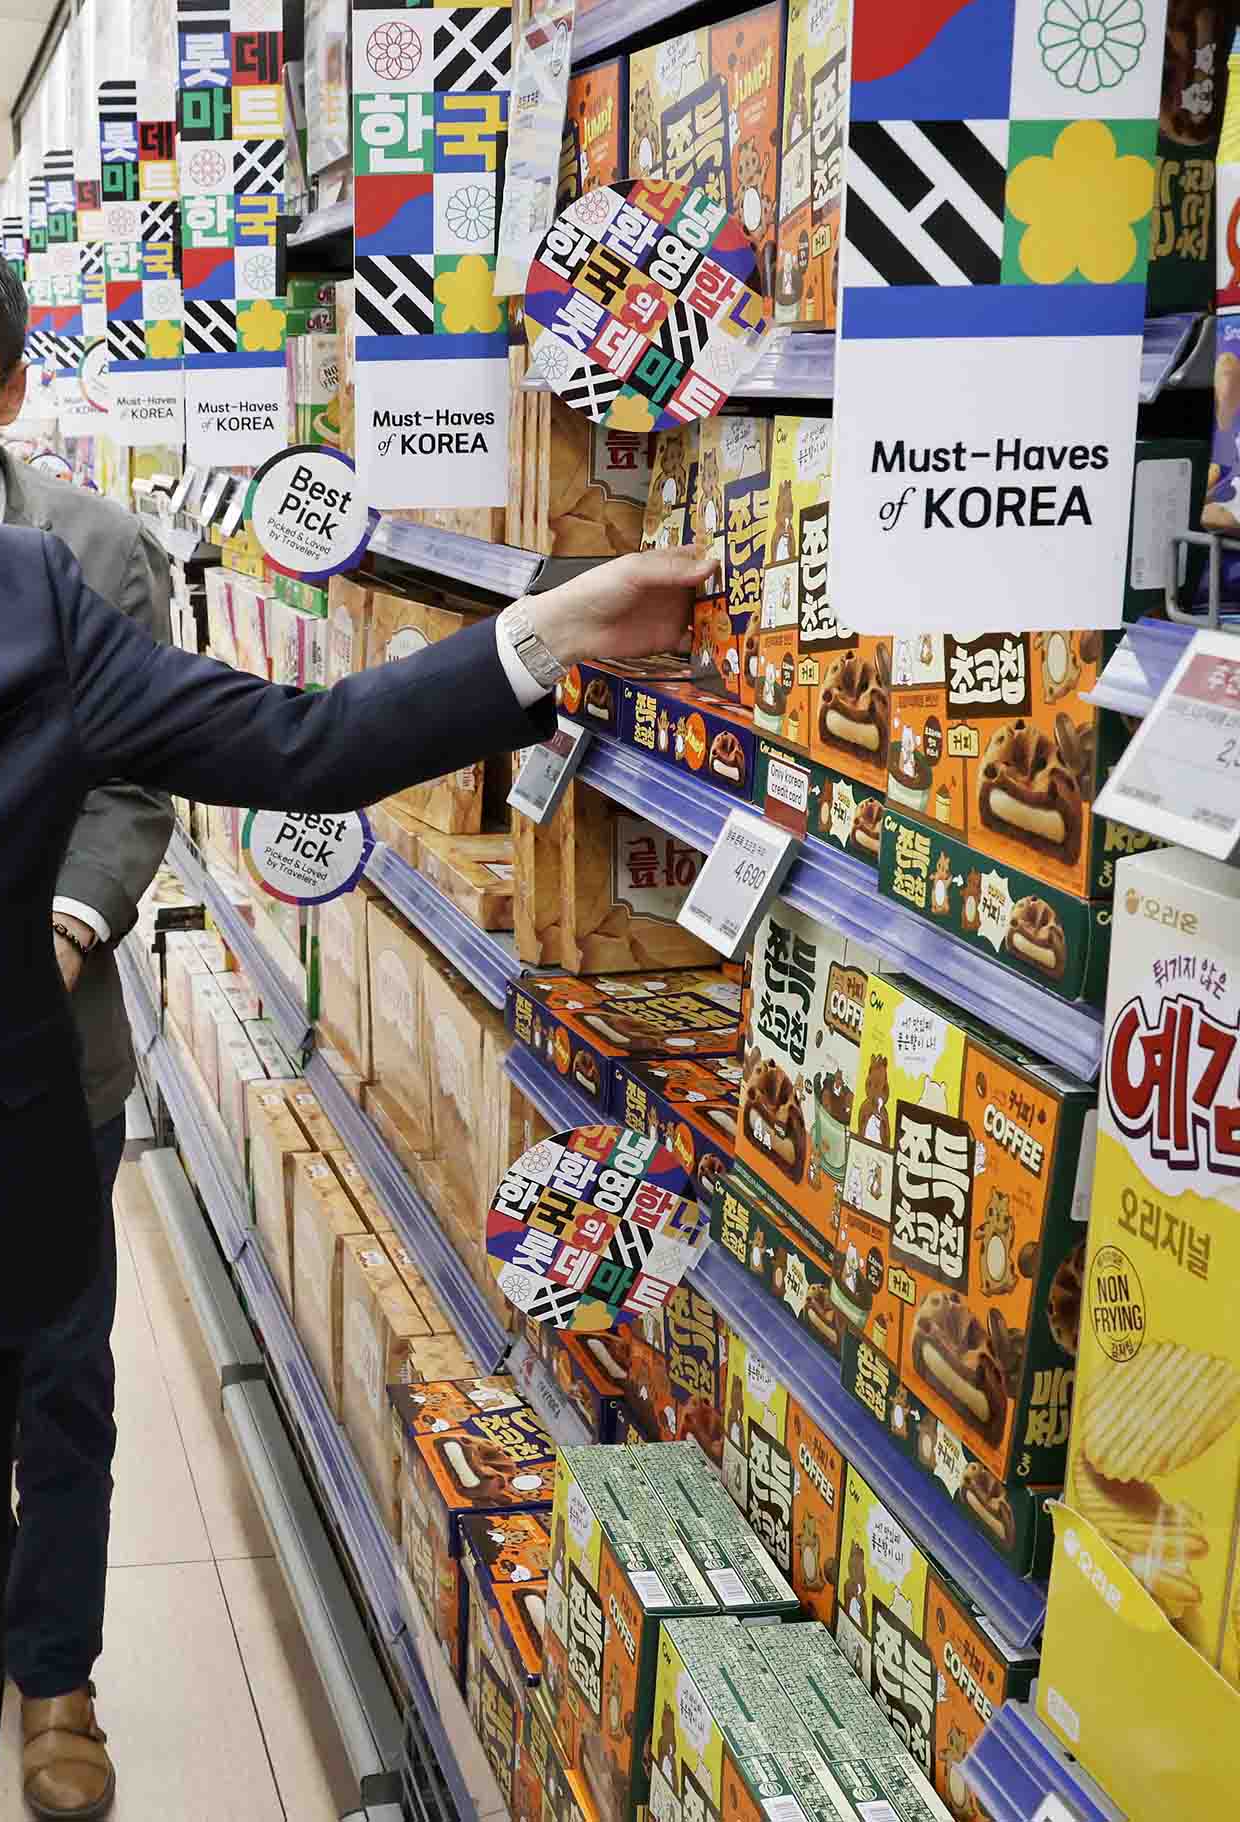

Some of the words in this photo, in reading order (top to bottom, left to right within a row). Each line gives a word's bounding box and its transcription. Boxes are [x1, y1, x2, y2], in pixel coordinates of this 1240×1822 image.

[181, 33, 279, 86] 롯데
[183, 88, 283, 139] 마트
[360, 93, 507, 173] 한국
[185, 195, 279, 248] 한국
[551, 293, 721, 423] 롯데마트
[131, 406, 174, 420] KOREA
[198, 400, 279, 415] Must-Haves
[216, 416, 275, 432] KOREA
[372, 408, 495, 428] Must-Haves
[377, 436, 394, 456] of
[400, 433, 489, 456] KOREA
[871, 437, 1109, 474] Must-Haves
[289, 464, 352, 516] Best
[878, 487, 916, 531] of
[924, 485, 1092, 529] KOREA
[267, 518, 297, 539] Picked
[305, 536, 331, 555] Loved
[278, 493, 340, 542] Pick
[268, 531, 281, 544] by
[281, 536, 321, 561] Travelers
[949, 639, 1025, 706] 초코칩
[770, 764, 784, 781] Only
[771, 783, 789, 800] credit
[788, 790, 802, 806] card
[264, 846, 294, 867] Picked
[301, 864, 328, 883] Loved
[274, 823, 336, 869] Pick
[266, 857, 278, 871] by
[278, 863, 318, 887] Travelers
[735, 860, 766, 889] 4,690
[1144, 898, 1199, 935] 오리온
[765, 918, 816, 1016] 쫀득
[1153, 956, 1197, 986] 튀기지
[1199, 960, 1227, 1000] 않은
[1009, 1090, 1035, 1128] 커피
[983, 1103, 1043, 1176] COFFEE
[896, 1113, 971, 1220] 쫀득
[891, 1199, 965, 1279] 초코칩
[1118, 1188, 1212, 1280] 오리지널
[512, 1229, 674, 1313] 롯데마트
[1097, 1274, 1129, 1304] NON
[1094, 1304, 1143, 1334] FRYING
[799, 1442, 835, 1506] COFFEE
[943, 1640, 992, 1723] COFFEE
